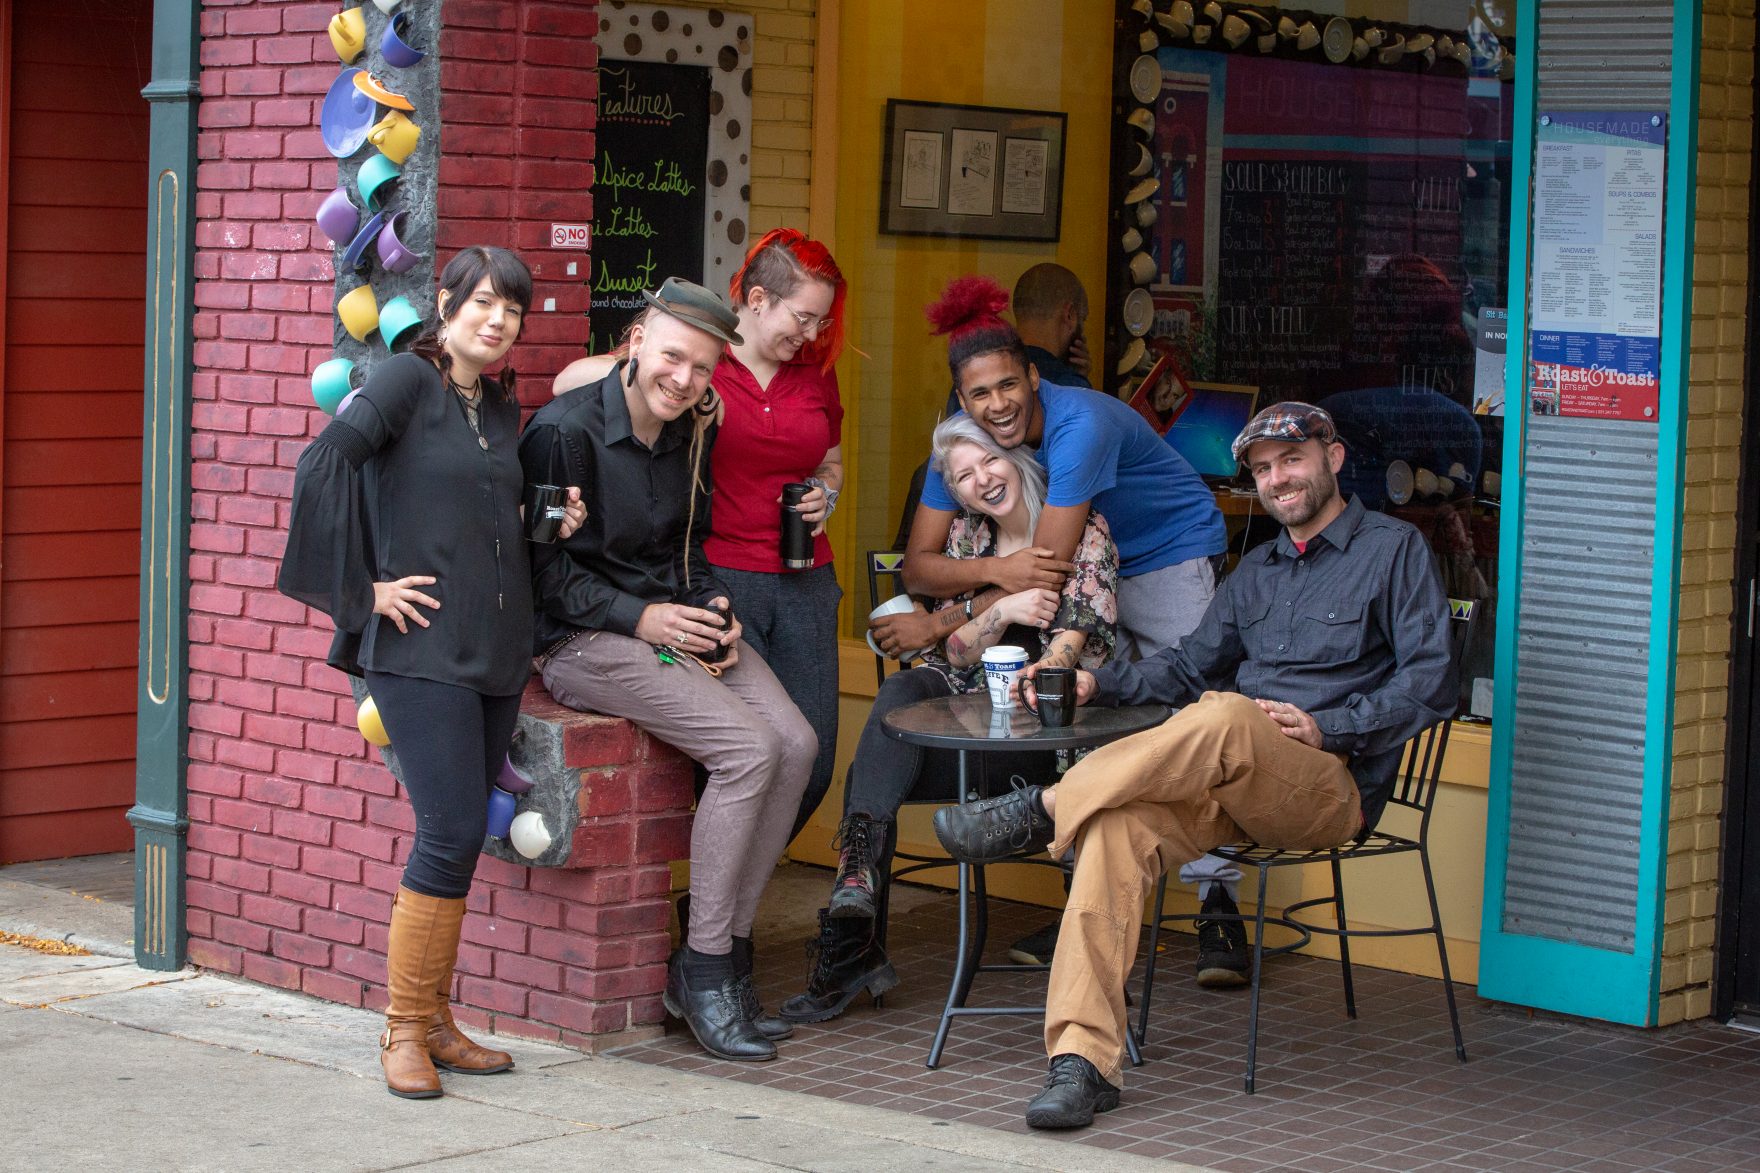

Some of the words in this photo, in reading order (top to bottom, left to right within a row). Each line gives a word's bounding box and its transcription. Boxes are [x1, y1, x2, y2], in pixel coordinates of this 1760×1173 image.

[593, 67, 685, 120] Features
[601, 150, 645, 203] Spice
[647, 159, 696, 196] Lattes
[605, 206, 659, 238] Lattes
[568, 228, 586, 240] NO
[594, 248, 657, 292] Sunset
[611, 295, 647, 309] chocolate
[1486, 310, 1495, 318] Sit
[1485, 331, 1493, 339] IN
[1539, 334, 1560, 342] DINNER
[1536, 364, 1588, 383] Roast
[1588, 363, 1606, 387] &
[1605, 368, 1655, 387] Toast
[1577, 384, 1589, 392] EAT
